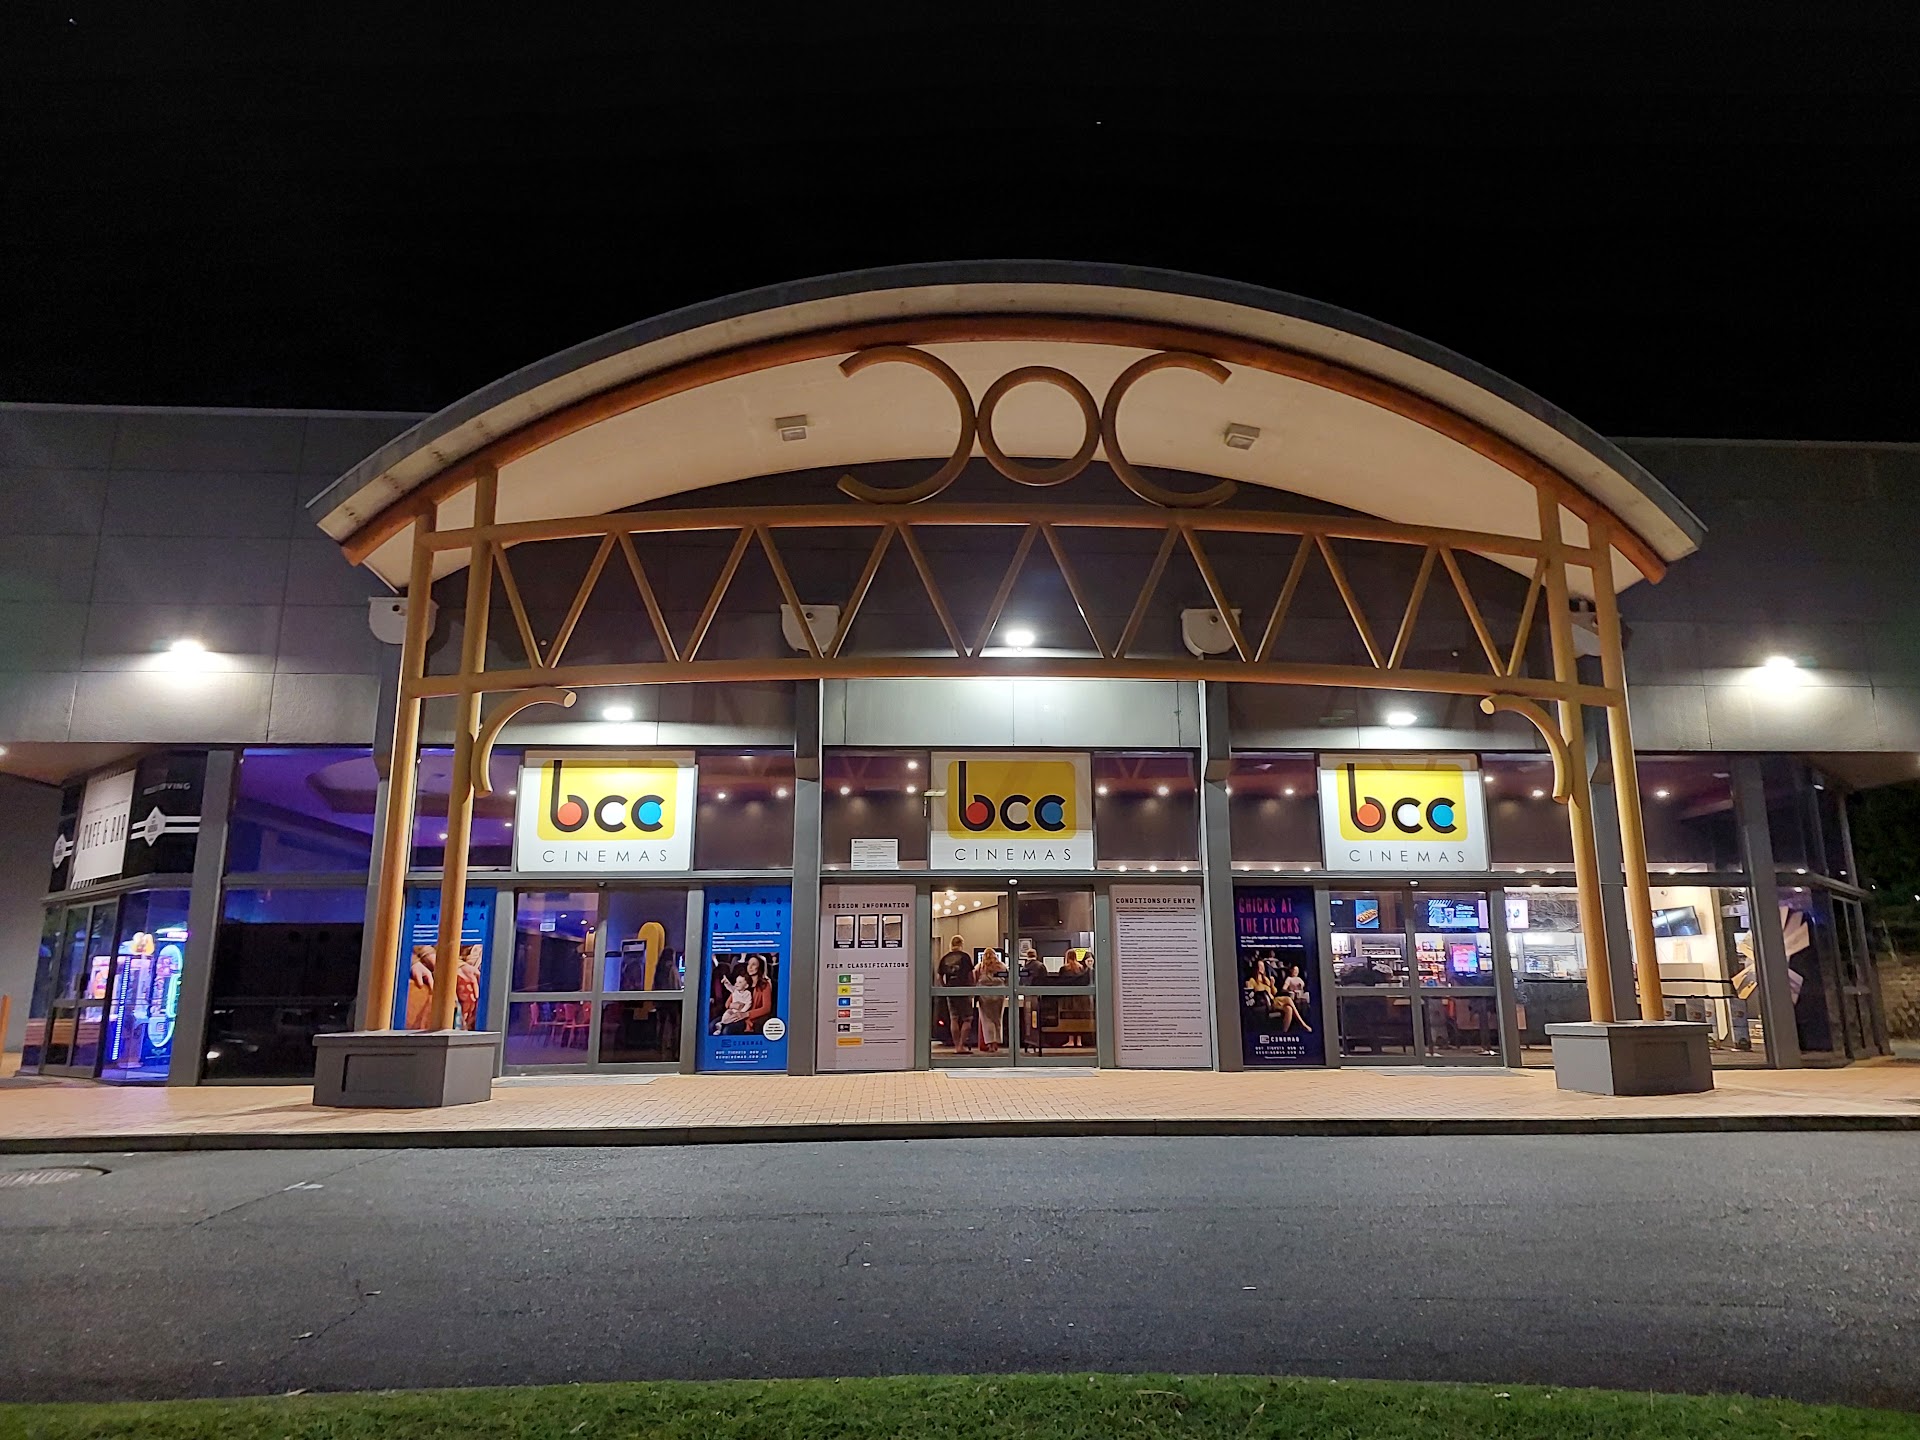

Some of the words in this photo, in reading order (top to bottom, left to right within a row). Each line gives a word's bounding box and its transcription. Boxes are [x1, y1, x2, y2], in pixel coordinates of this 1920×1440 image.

[550, 760, 665, 833] bcc
[958, 761, 1066, 831] bcc
[1347, 763, 1457, 833] bcc
[110, 813, 127, 843] BAR
[542, 849, 668, 863] CINEMAS
[954, 848, 1072, 861] CINEMAS
[1349, 849, 1465, 863] CINEMAS
[416, 900, 486, 909] CIMA
[1239, 897, 1276, 913] CHICKS
[1281, 897, 1292, 913] AT
[415, 912, 485, 921] INIA
[714, 910, 782, 918] YOUR
[713, 922, 781, 930] BABY
[1240, 917, 1258, 934] THE
[1263, 917, 1300, 934] FLICKS
